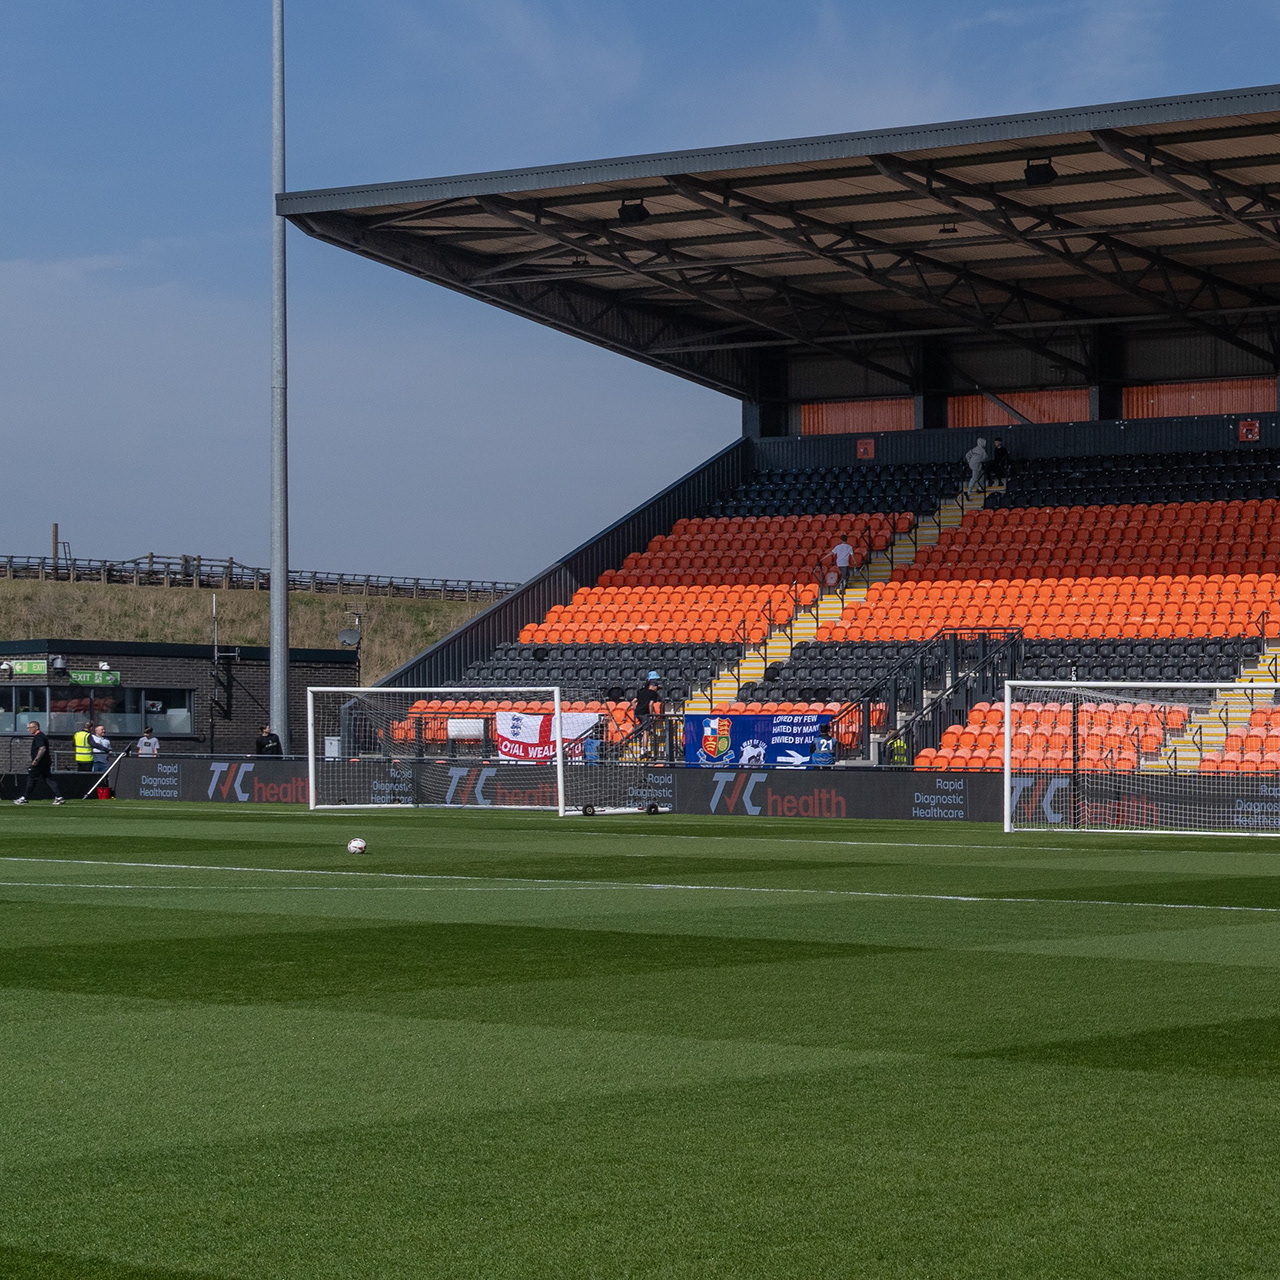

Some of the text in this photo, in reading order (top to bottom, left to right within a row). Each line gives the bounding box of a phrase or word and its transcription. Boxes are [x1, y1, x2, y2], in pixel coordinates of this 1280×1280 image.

[71, 673, 91, 681] EXIT
[793, 715, 803, 723] BY
[772, 725, 792, 734] HATED
[793, 726, 802, 734] BY
[794, 736, 804, 744] BY
[820, 739, 833, 751] 21
[157, 763, 178, 775] Rapid
[141, 775, 178, 787] Diagnostic
[647, 773, 673, 786] Rapid
[935, 778, 964, 793] Rapid
[140, 786, 178, 798] Healthcare
[767, 787, 847, 817] health
[913, 792, 964, 807] Diagnostic
[912, 806, 964, 819] Healthcare
